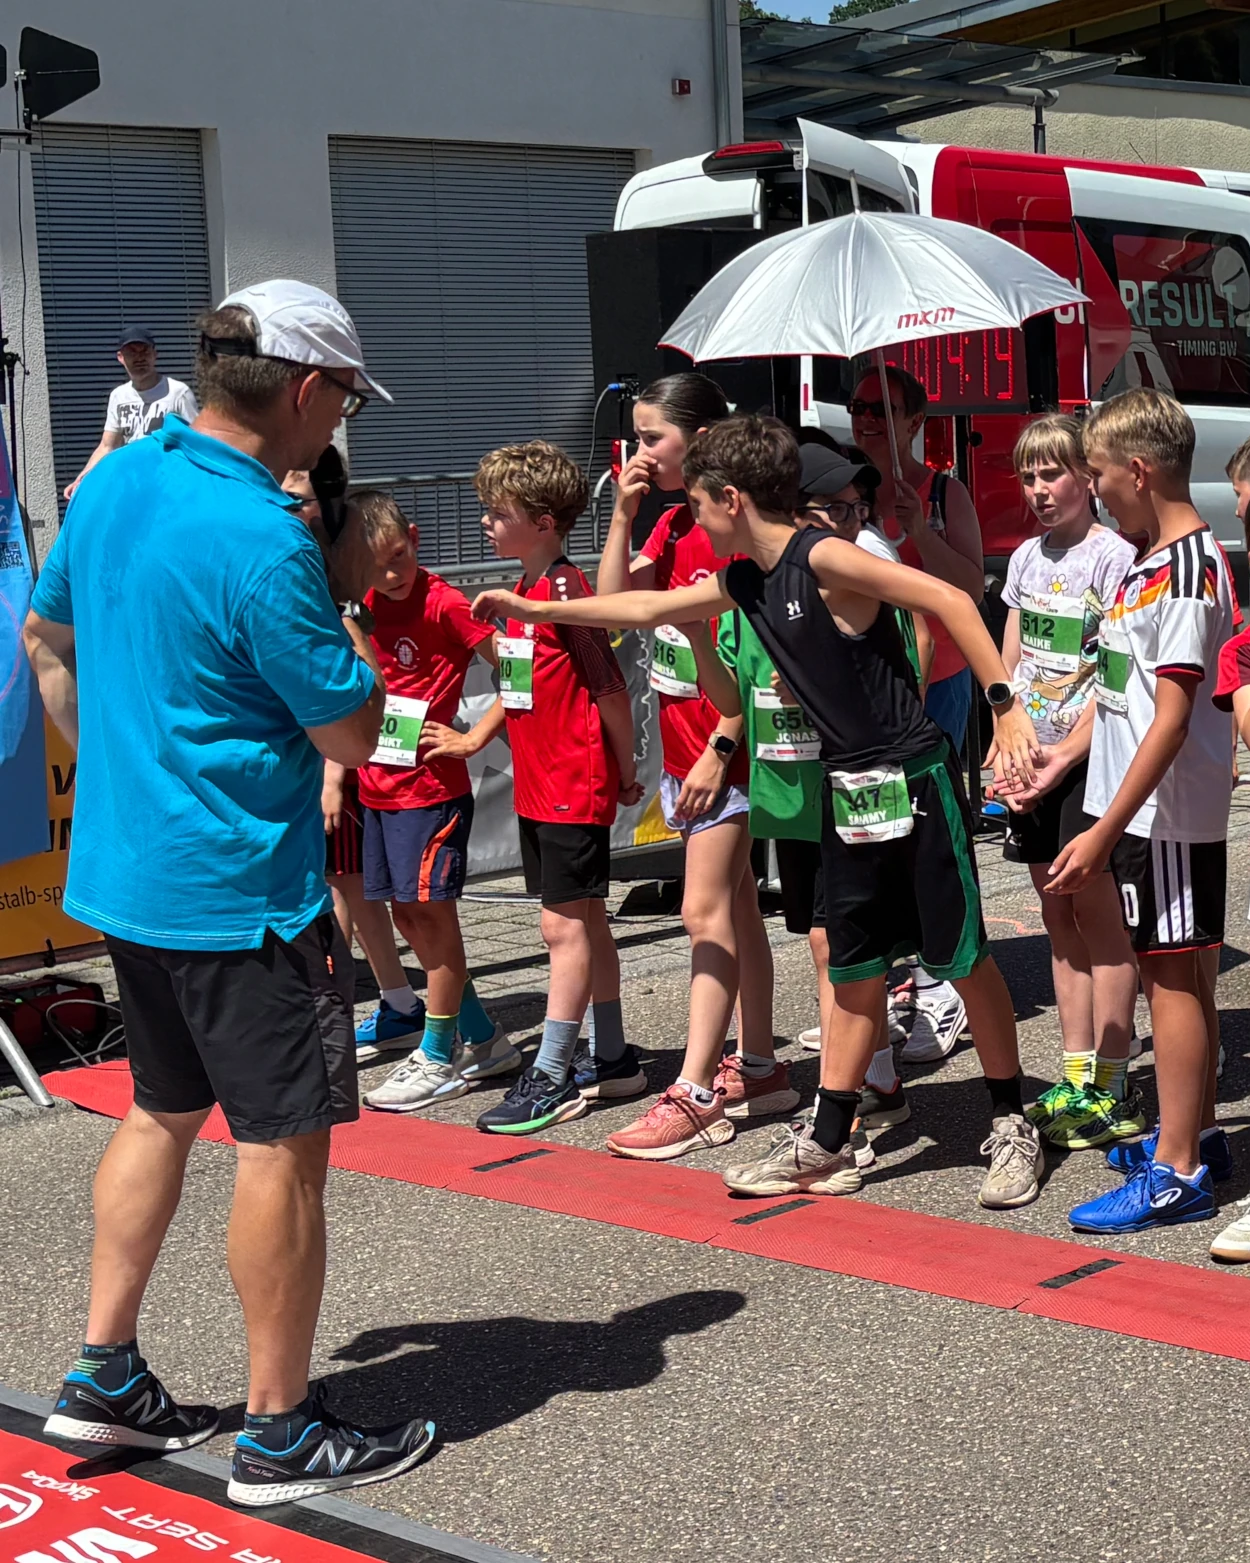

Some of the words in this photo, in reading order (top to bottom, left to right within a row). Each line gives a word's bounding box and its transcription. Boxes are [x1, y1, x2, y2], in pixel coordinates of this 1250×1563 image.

[1119, 279, 1238, 328] RESULT
[897, 306, 956, 329] mxm
[1176, 339, 1216, 357] TIMING
[1219, 341, 1238, 357] BW
[1021, 612, 1056, 638] 512
[775, 730, 820, 744] JONAS
[847, 809, 888, 826] SAMMY
[21, 1469, 101, 1502] ŠKODA
[101, 1505, 230, 1551] SEAT
